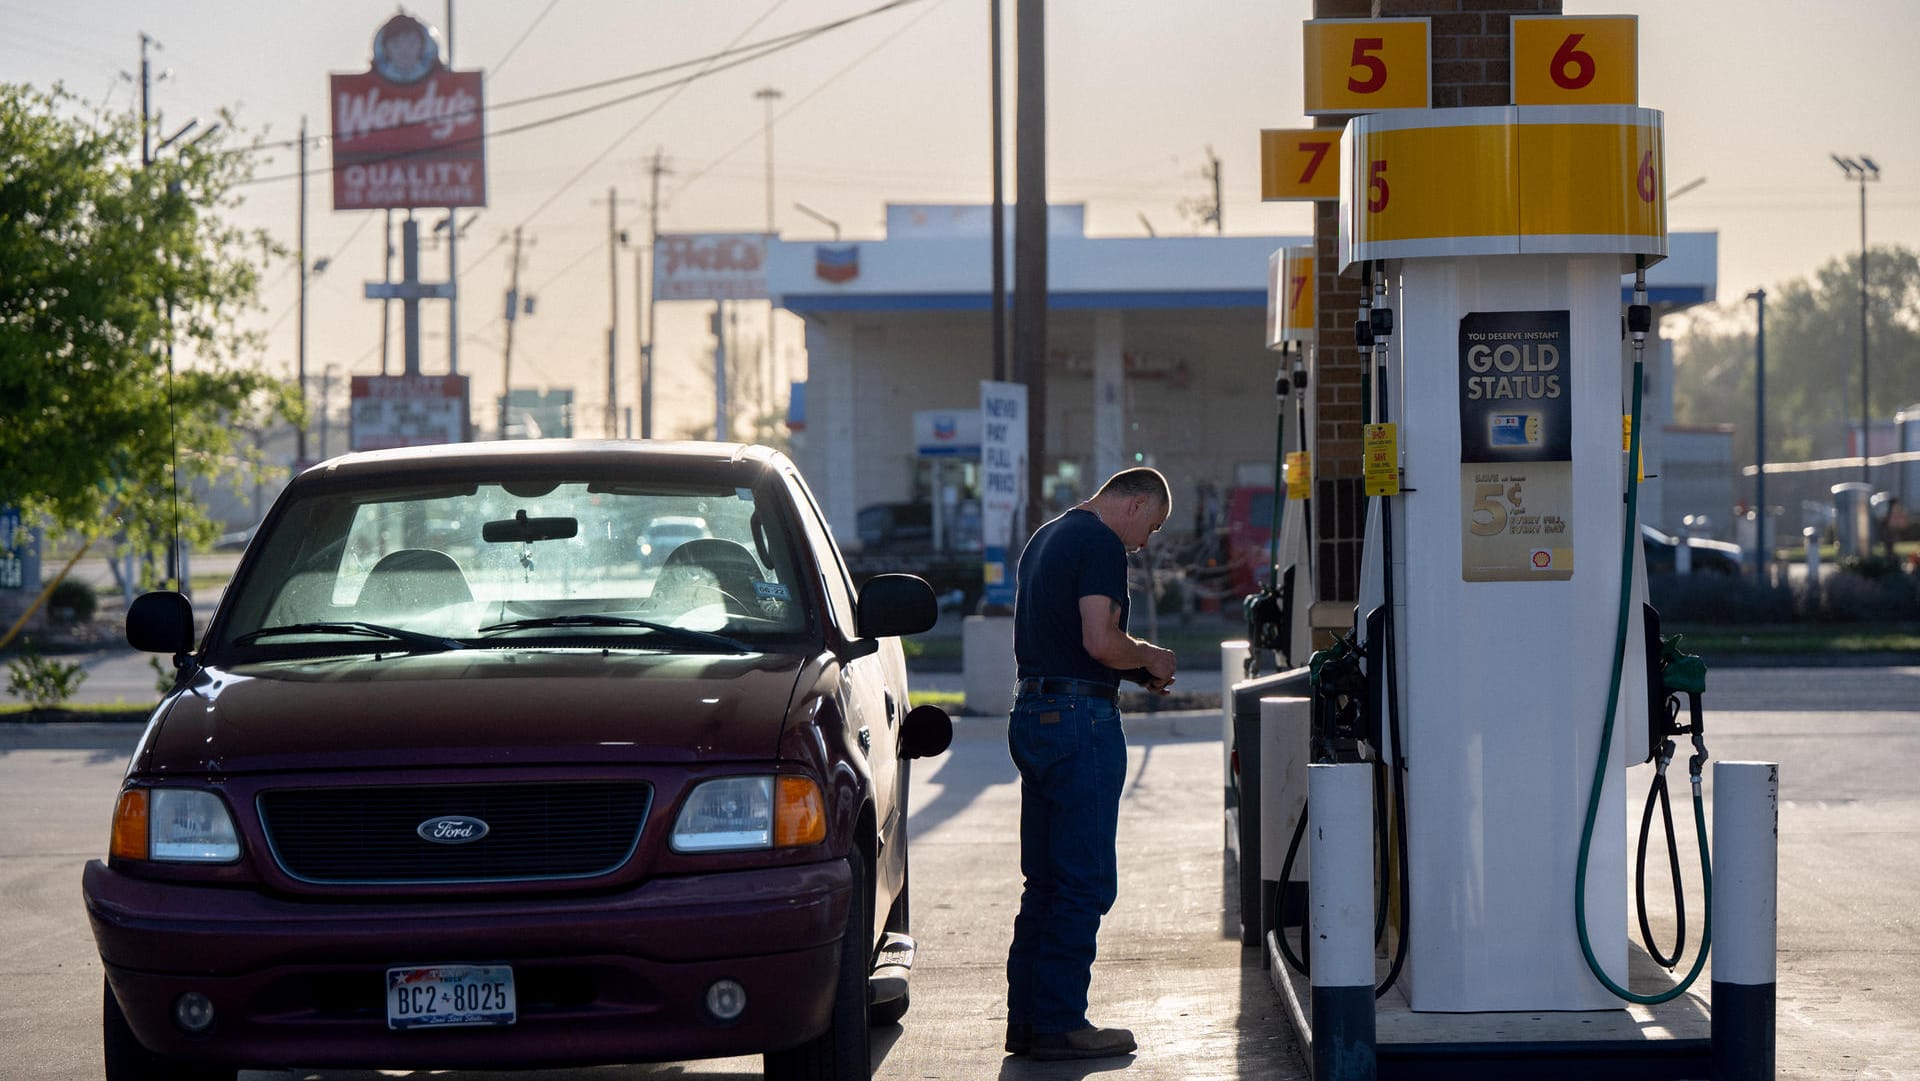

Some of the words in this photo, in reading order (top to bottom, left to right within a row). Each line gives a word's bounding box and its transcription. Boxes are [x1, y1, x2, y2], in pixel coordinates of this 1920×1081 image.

[1348, 37, 1388, 94] 5
[1550, 33, 1596, 90] 6
[344, 162, 473, 188] QUALITY
[1297, 142, 1331, 184] 7
[1637, 151, 1656, 203] 6
[1367, 160, 1389, 214] 5
[1291, 277, 1308, 310] 7
[1488, 332, 1522, 340] DESERVE
[1524, 331, 1559, 339] INSTANT
[1467, 344, 1560, 373] GOLD
[1468, 375, 1561, 399] STATUS
[434, 821, 473, 837] Ford
[398, 986, 437, 1015] BC2
[454, 983, 506, 1012] 8025
